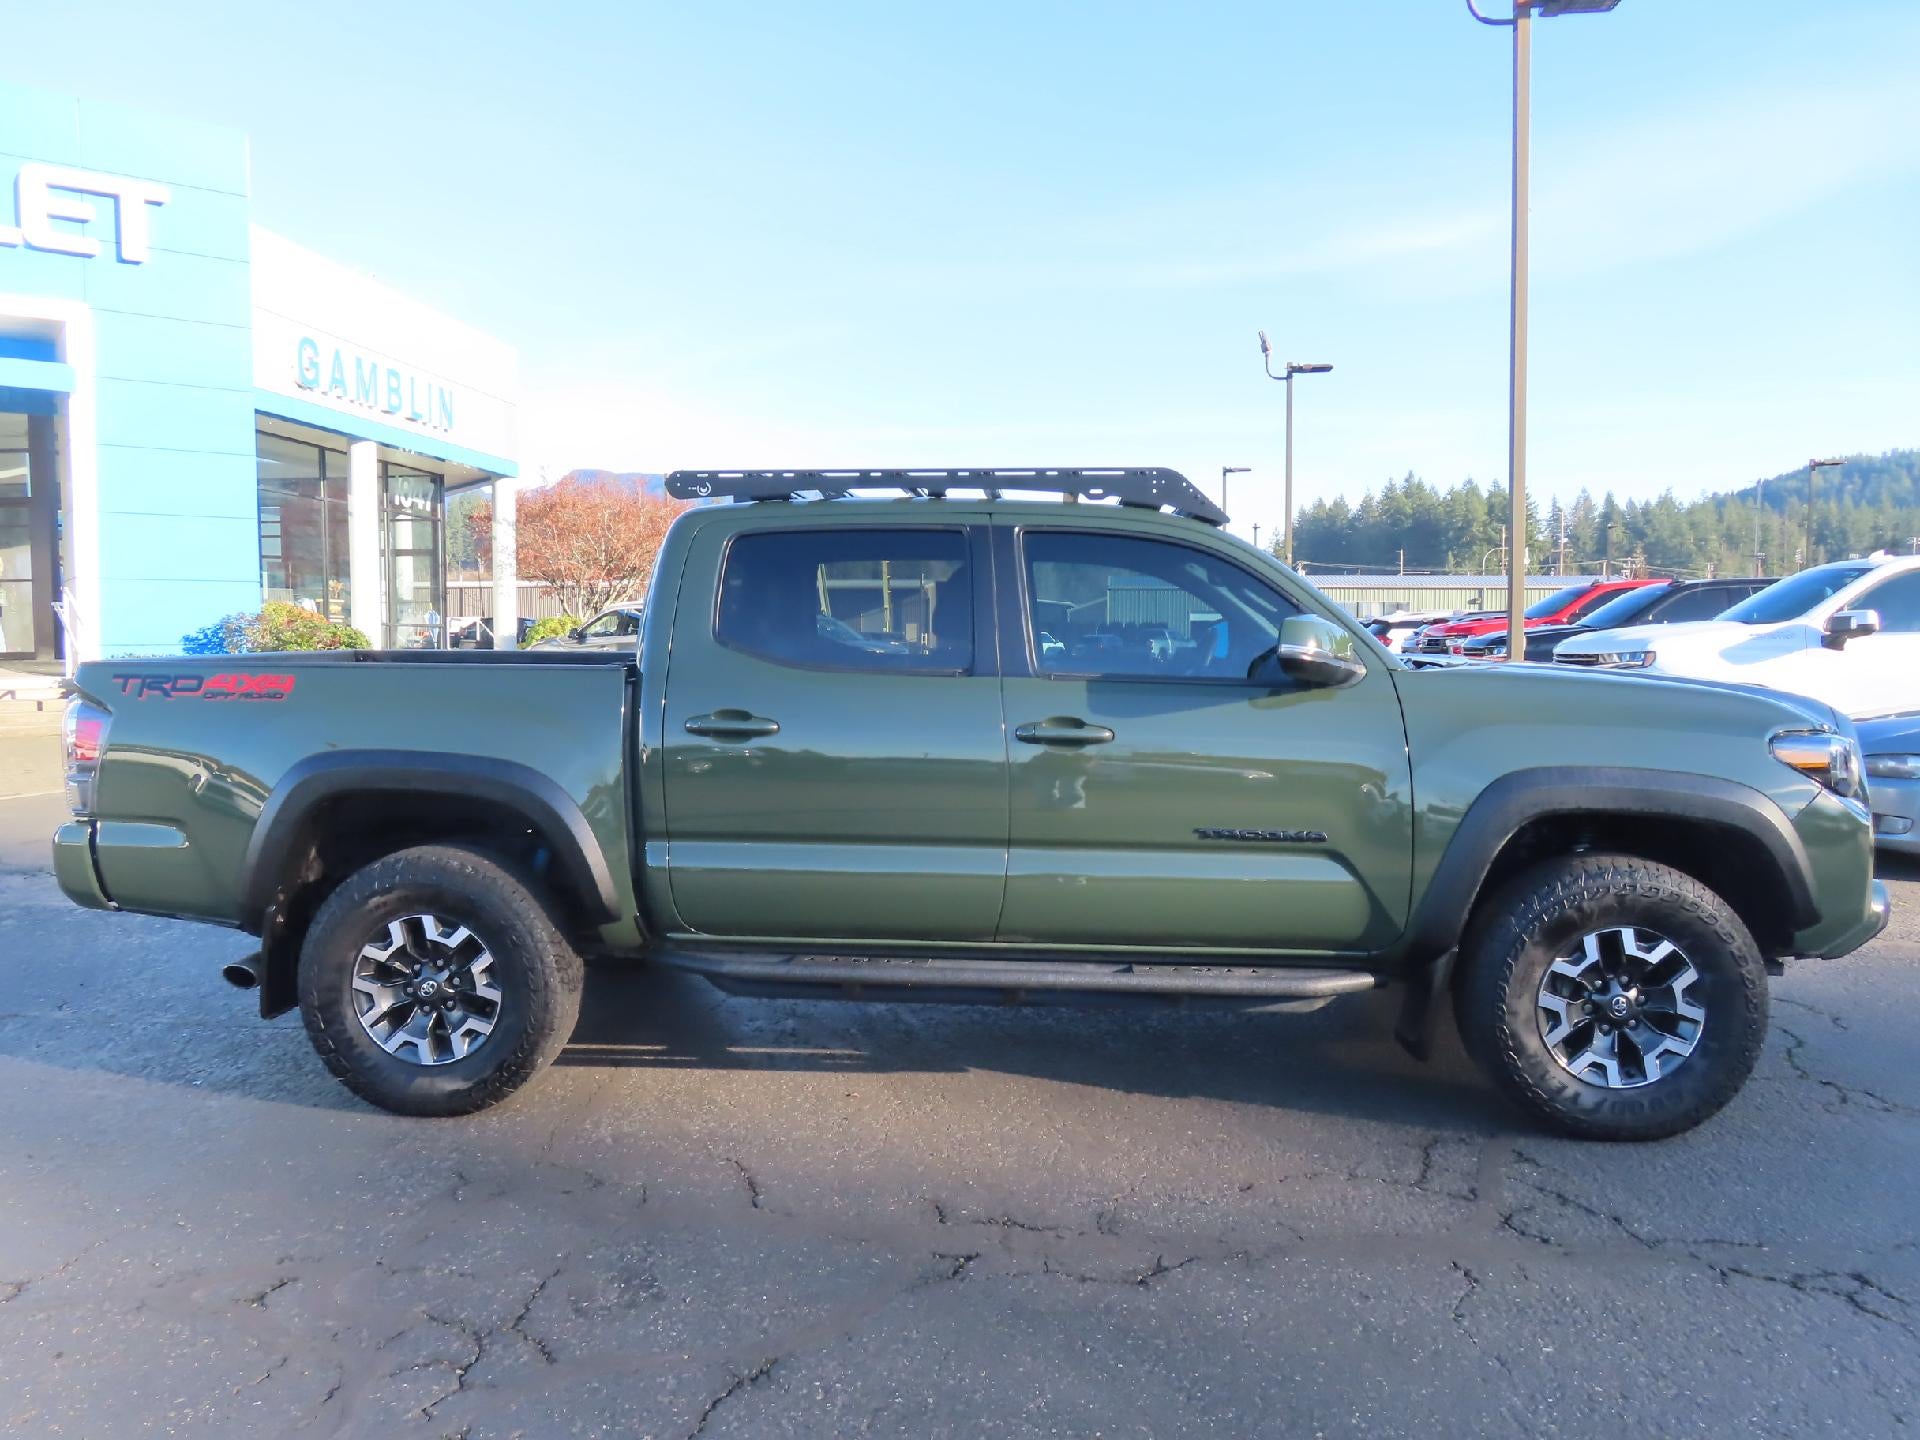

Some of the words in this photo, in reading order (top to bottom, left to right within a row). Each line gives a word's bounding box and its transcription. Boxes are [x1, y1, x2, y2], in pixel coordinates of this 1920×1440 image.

[297, 336, 454, 430] GAMBLIN
[112, 673, 205, 700] TRD
[203, 691, 236, 701] OFF
[238, 692, 289, 701] ROAD
[1192, 827, 1328, 842] TACOMA
